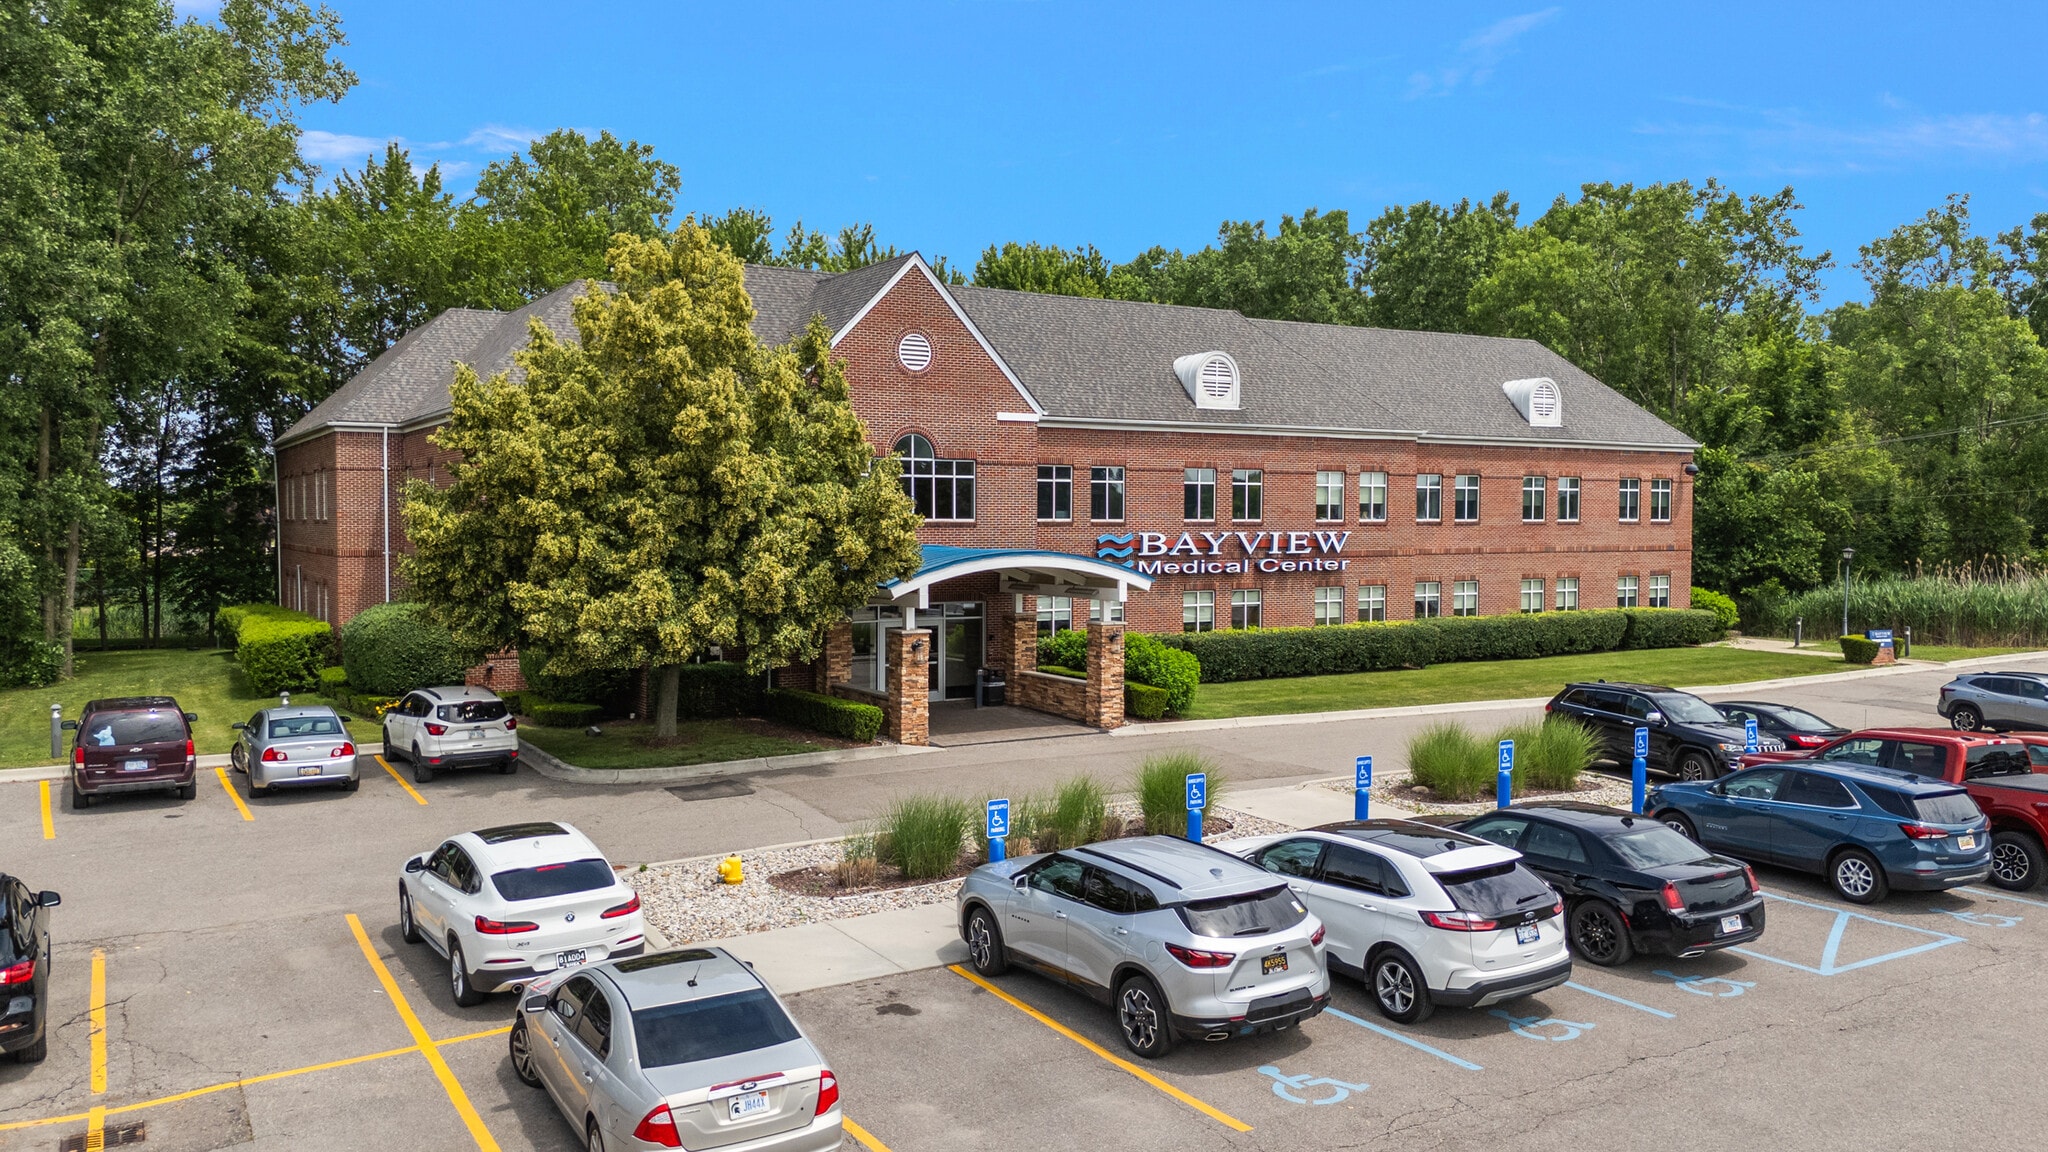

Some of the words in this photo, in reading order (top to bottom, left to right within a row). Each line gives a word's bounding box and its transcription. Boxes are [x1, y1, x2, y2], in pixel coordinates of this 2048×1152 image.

[1138, 531, 1352, 556] BAYVIEW
[1138, 559, 1249, 575] Medical
[1258, 557, 1351, 573] Center
